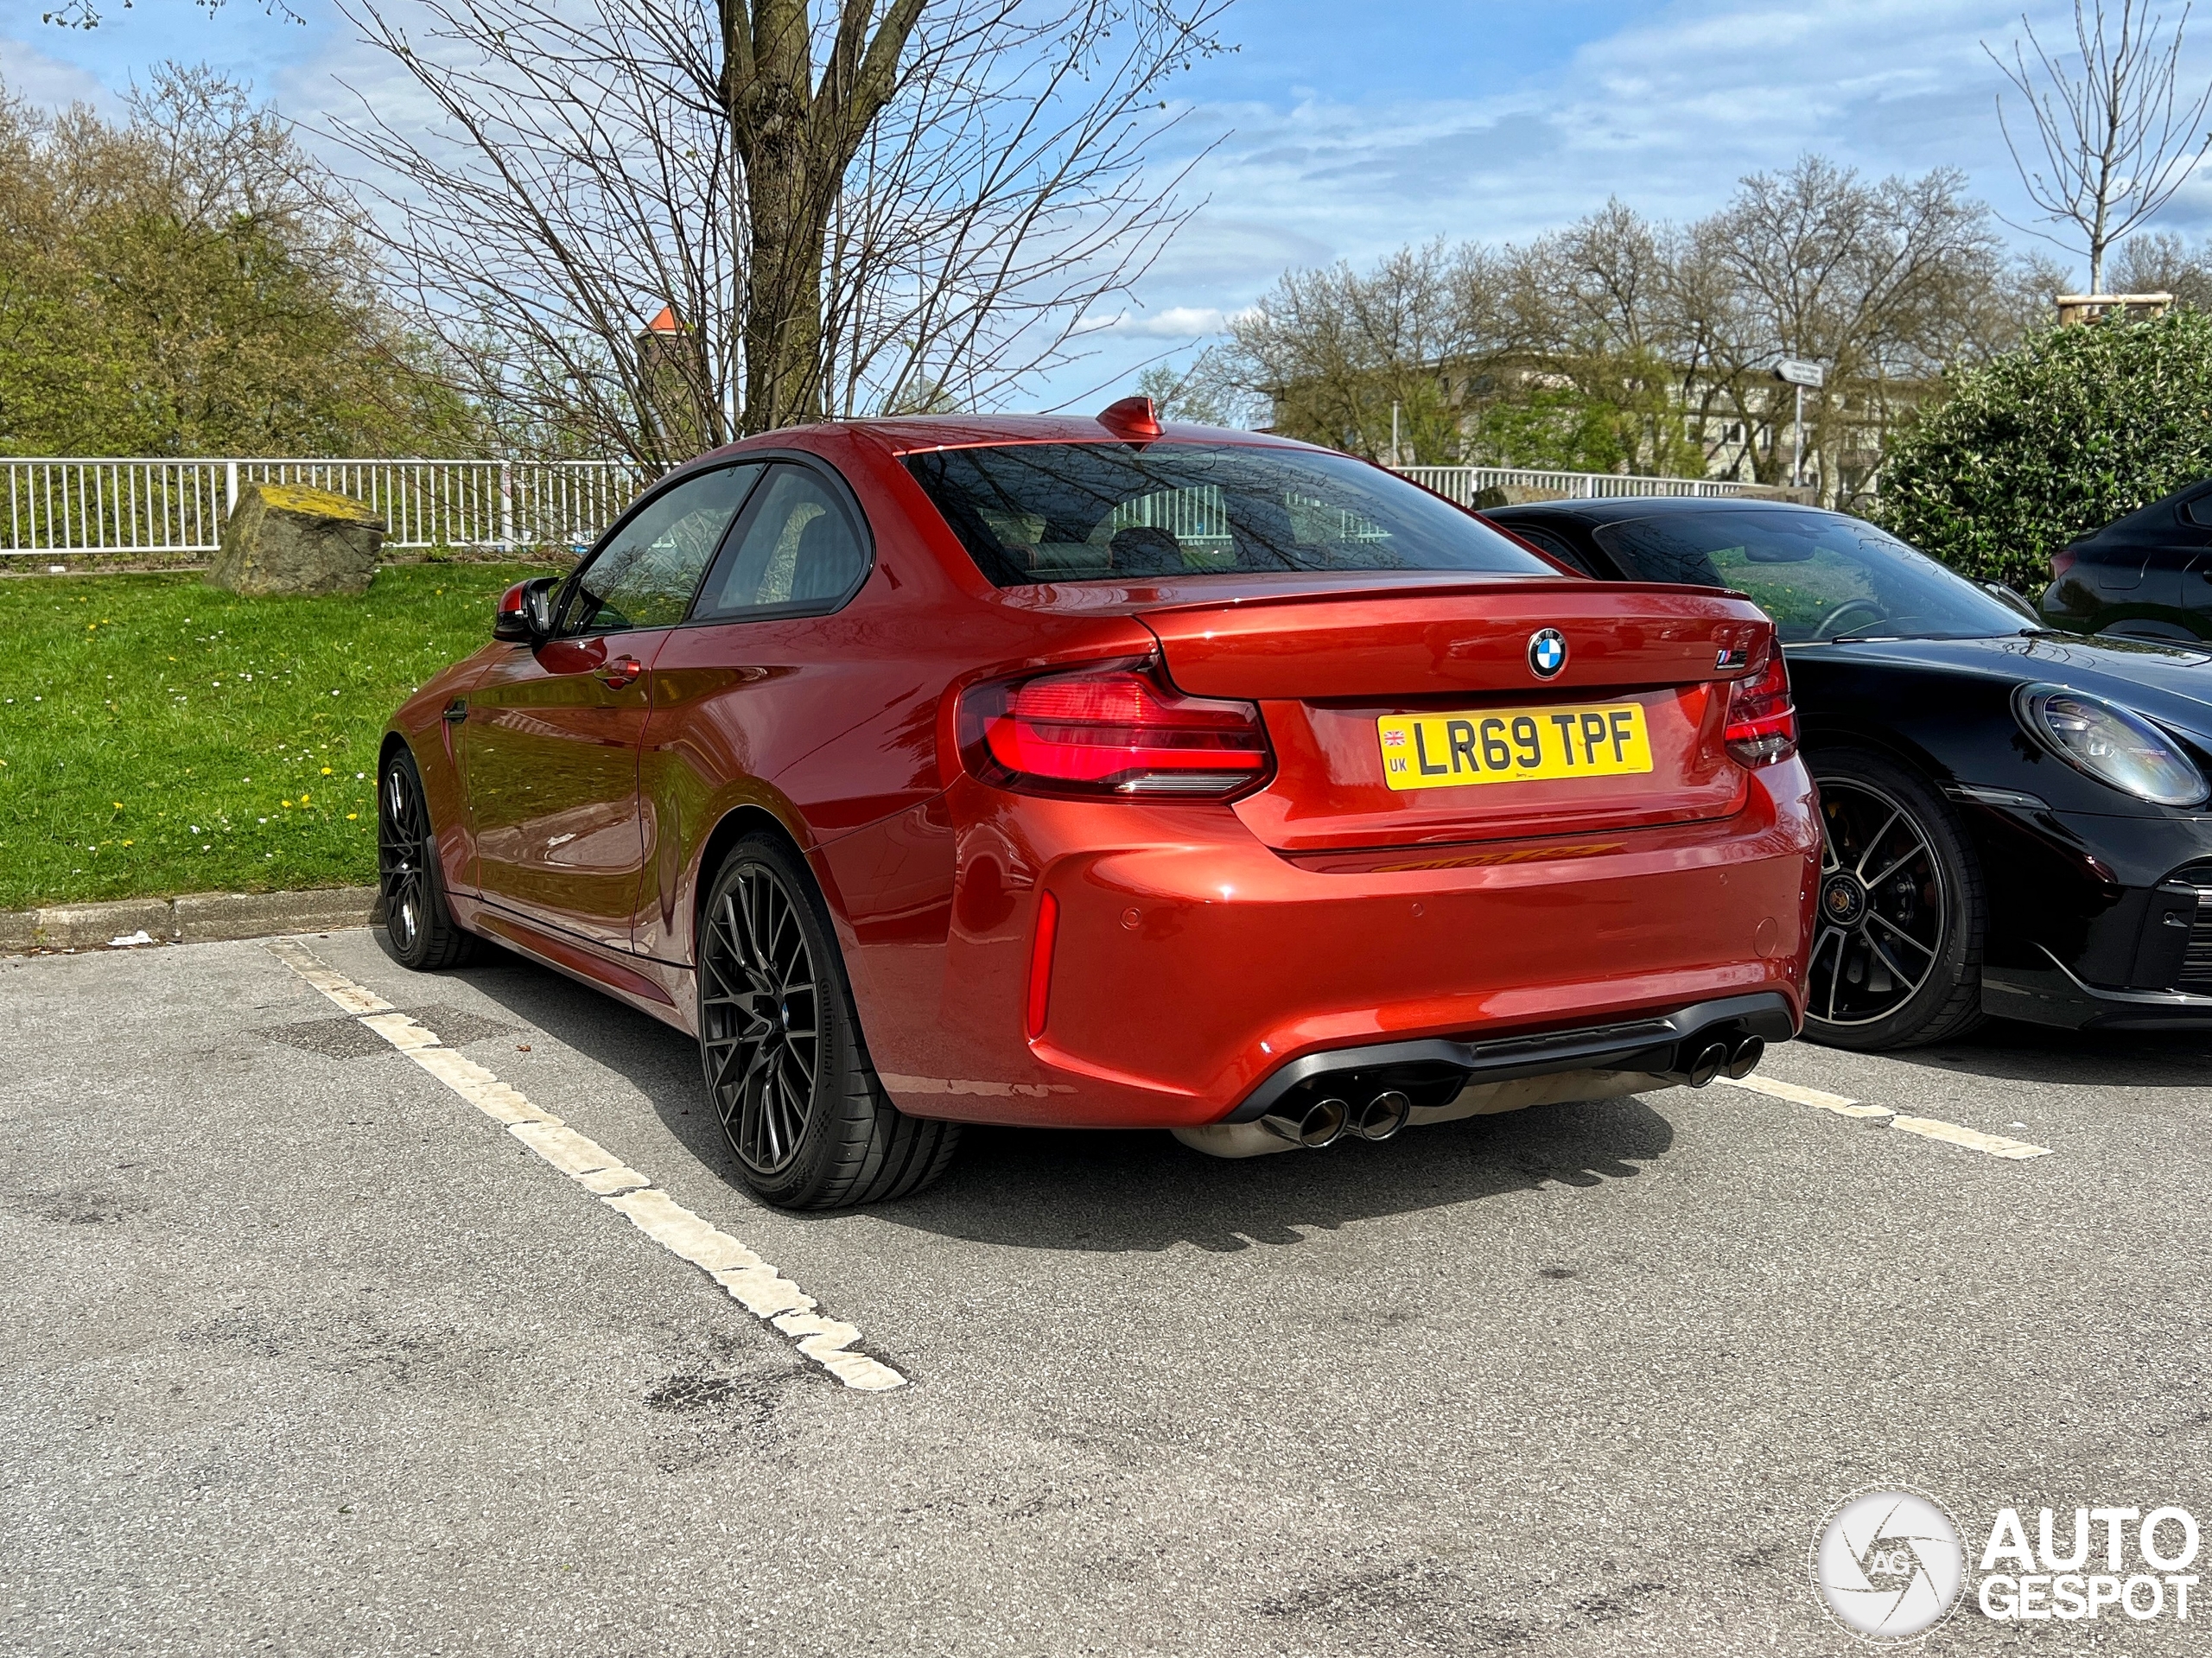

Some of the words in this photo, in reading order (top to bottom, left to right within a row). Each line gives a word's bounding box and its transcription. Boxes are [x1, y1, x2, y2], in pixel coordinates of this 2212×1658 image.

[1535, 630, 1565, 646] BMW
[1414, 716, 1541, 775] LR69
[1551, 711, 1632, 765] TPF
[1389, 758, 1408, 772] UK
[820, 980, 835, 1077] Continental
